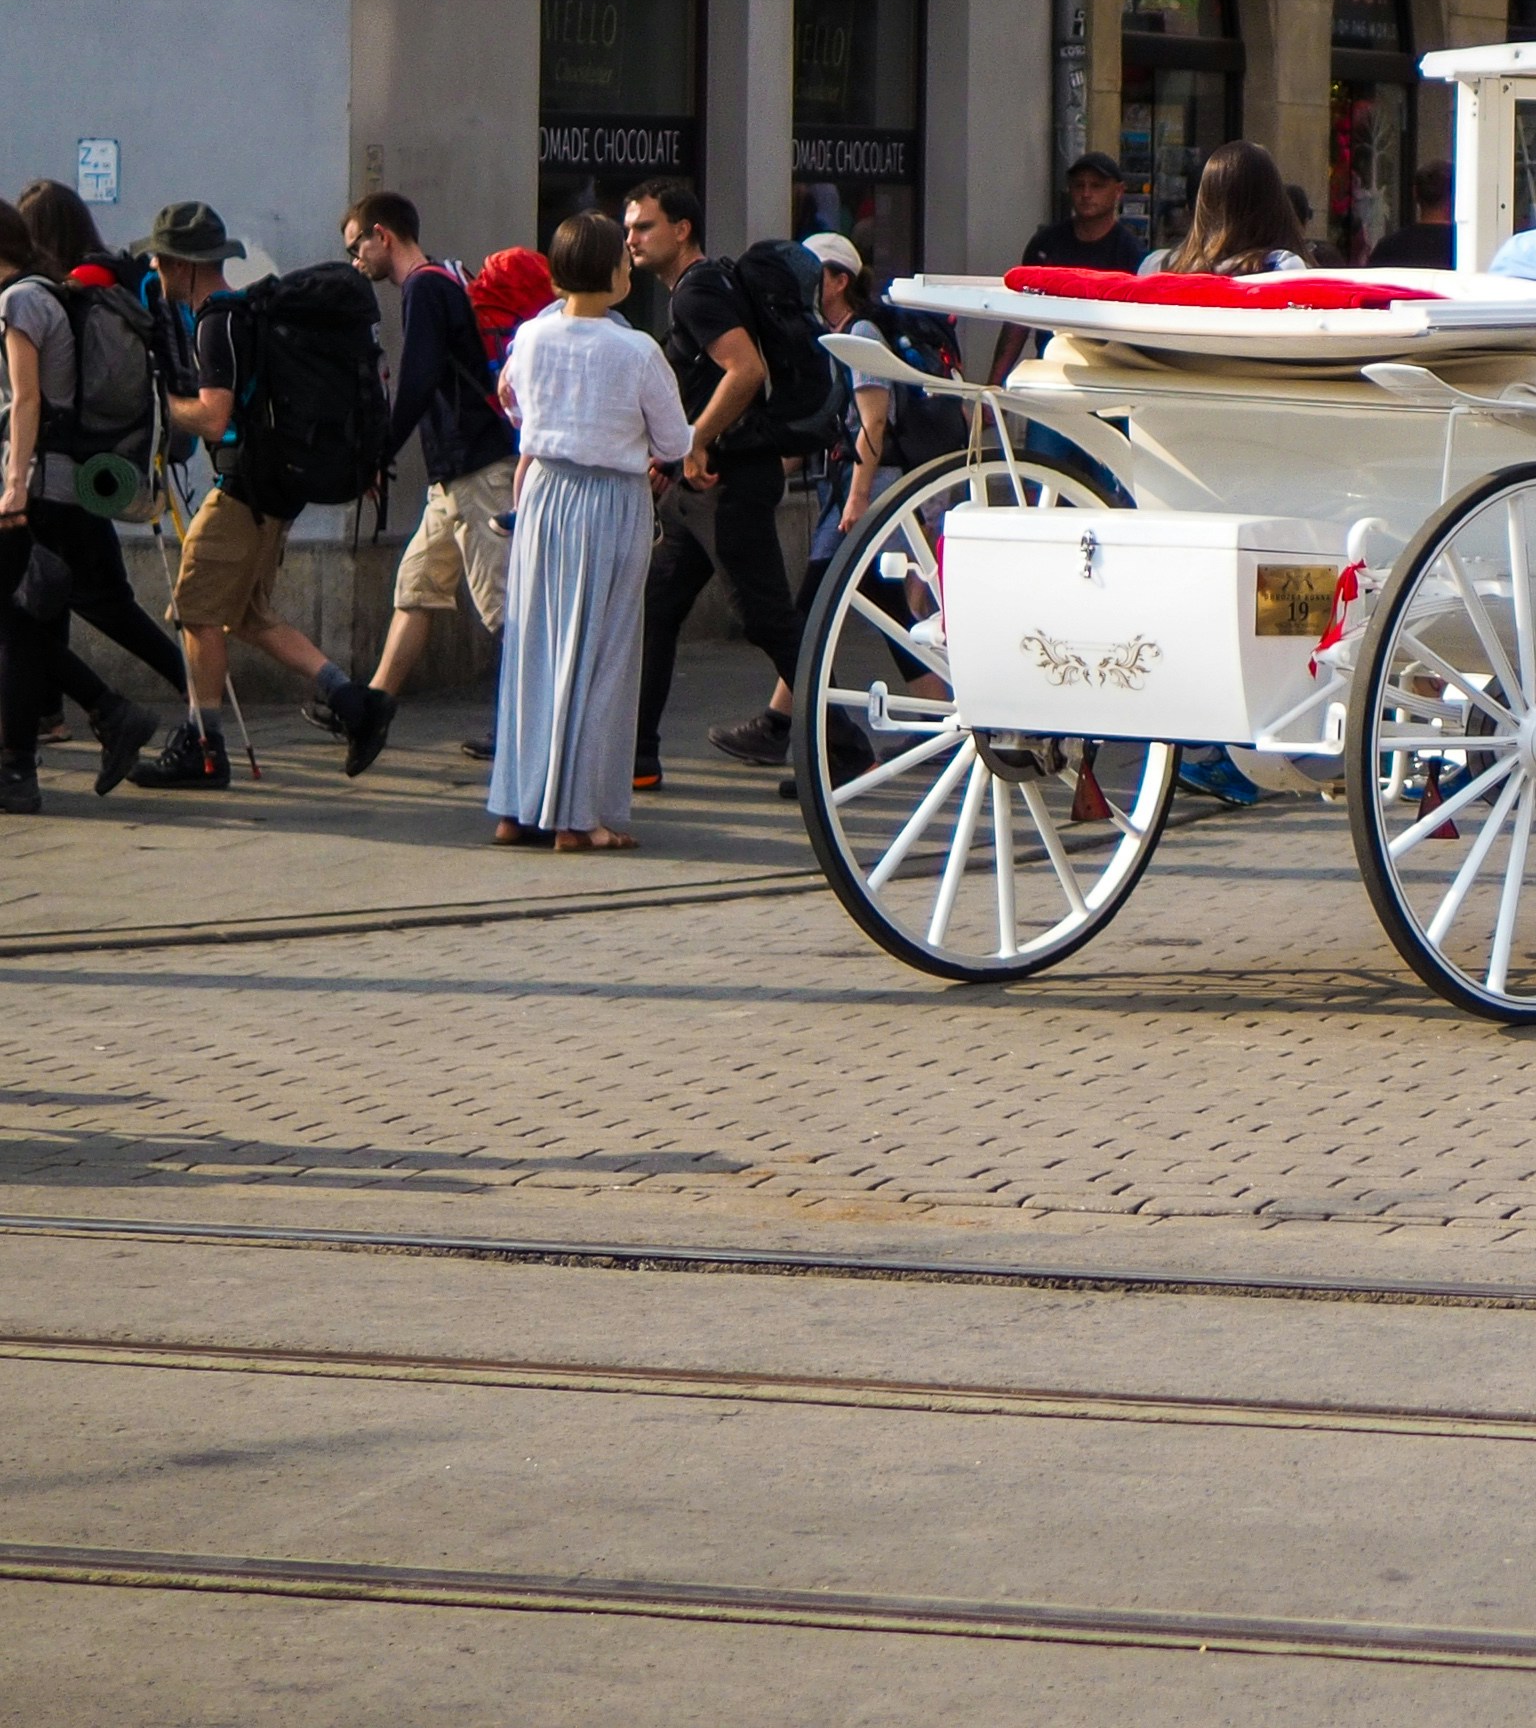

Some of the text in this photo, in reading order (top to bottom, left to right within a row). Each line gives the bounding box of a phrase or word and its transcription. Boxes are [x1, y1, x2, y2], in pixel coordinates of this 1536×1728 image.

[594, 128, 681, 164] CHOCOLATE
[835, 140, 905, 174] CHOCOLATE
[1288, 601, 1309, 622] 19
